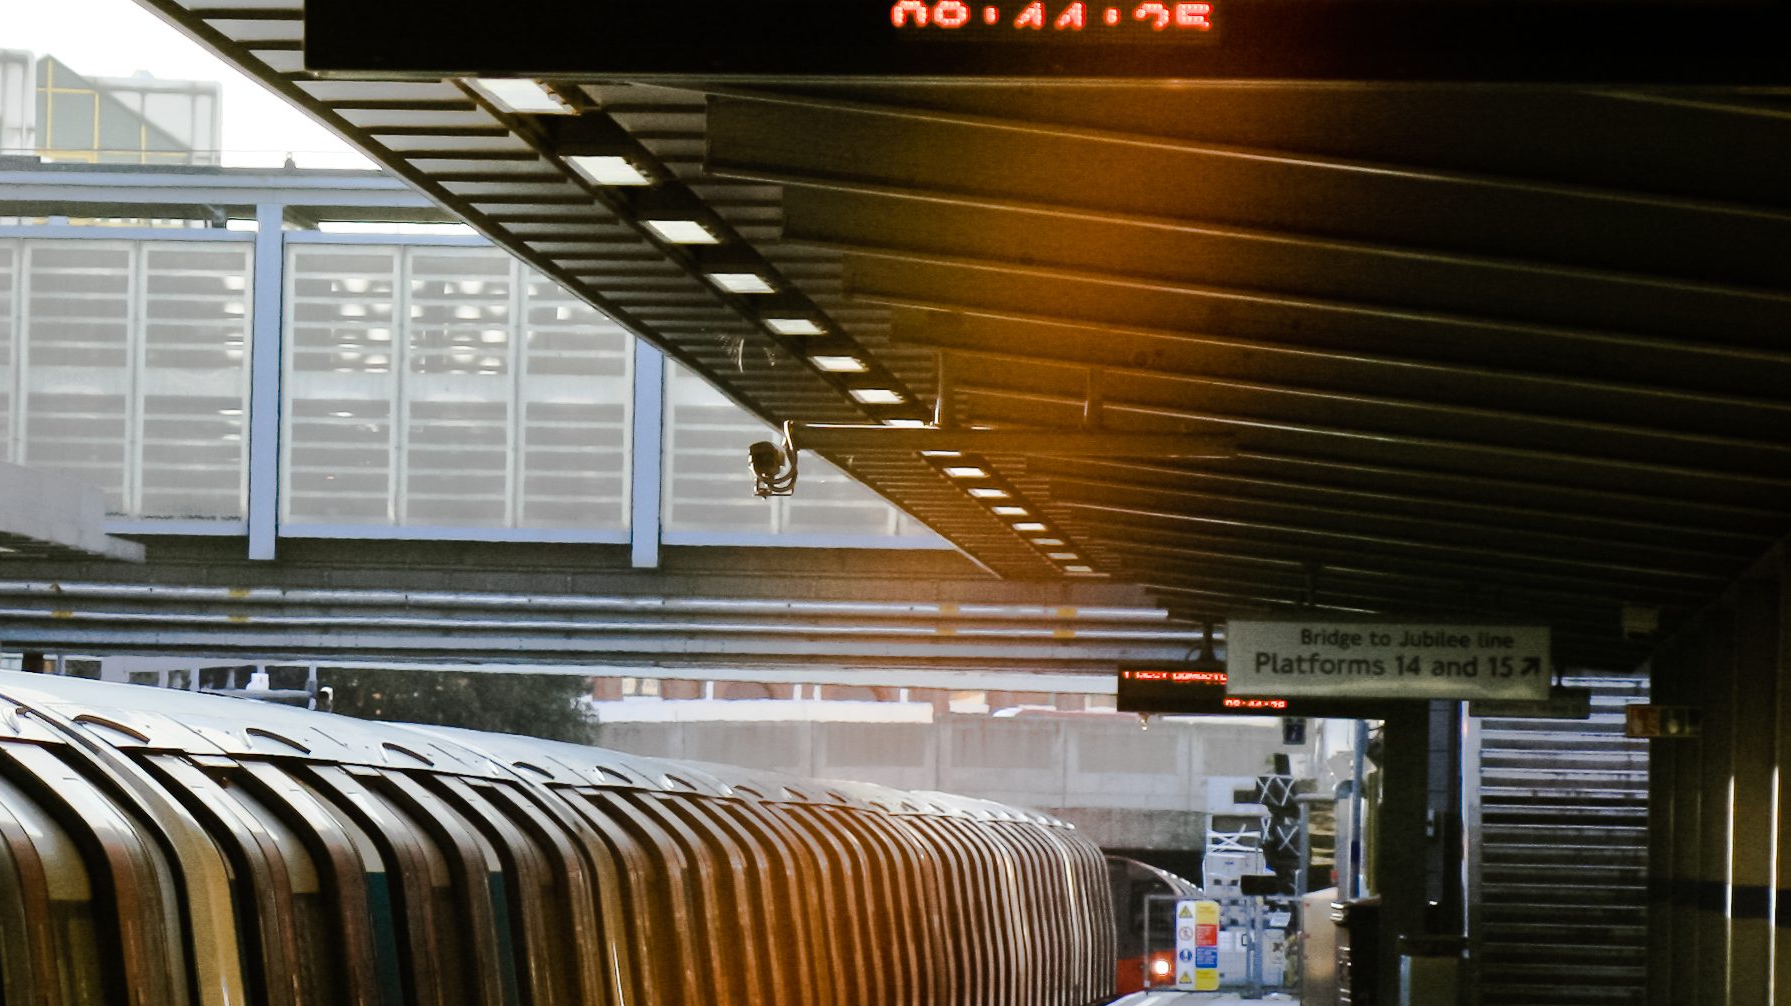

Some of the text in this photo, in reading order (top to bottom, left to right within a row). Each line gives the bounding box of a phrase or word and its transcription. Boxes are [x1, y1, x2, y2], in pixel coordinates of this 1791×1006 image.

[1301, 628, 1514, 650] Bridge to Jubilee line
[1255, 652, 1514, 678] Platforms 14 and 15
